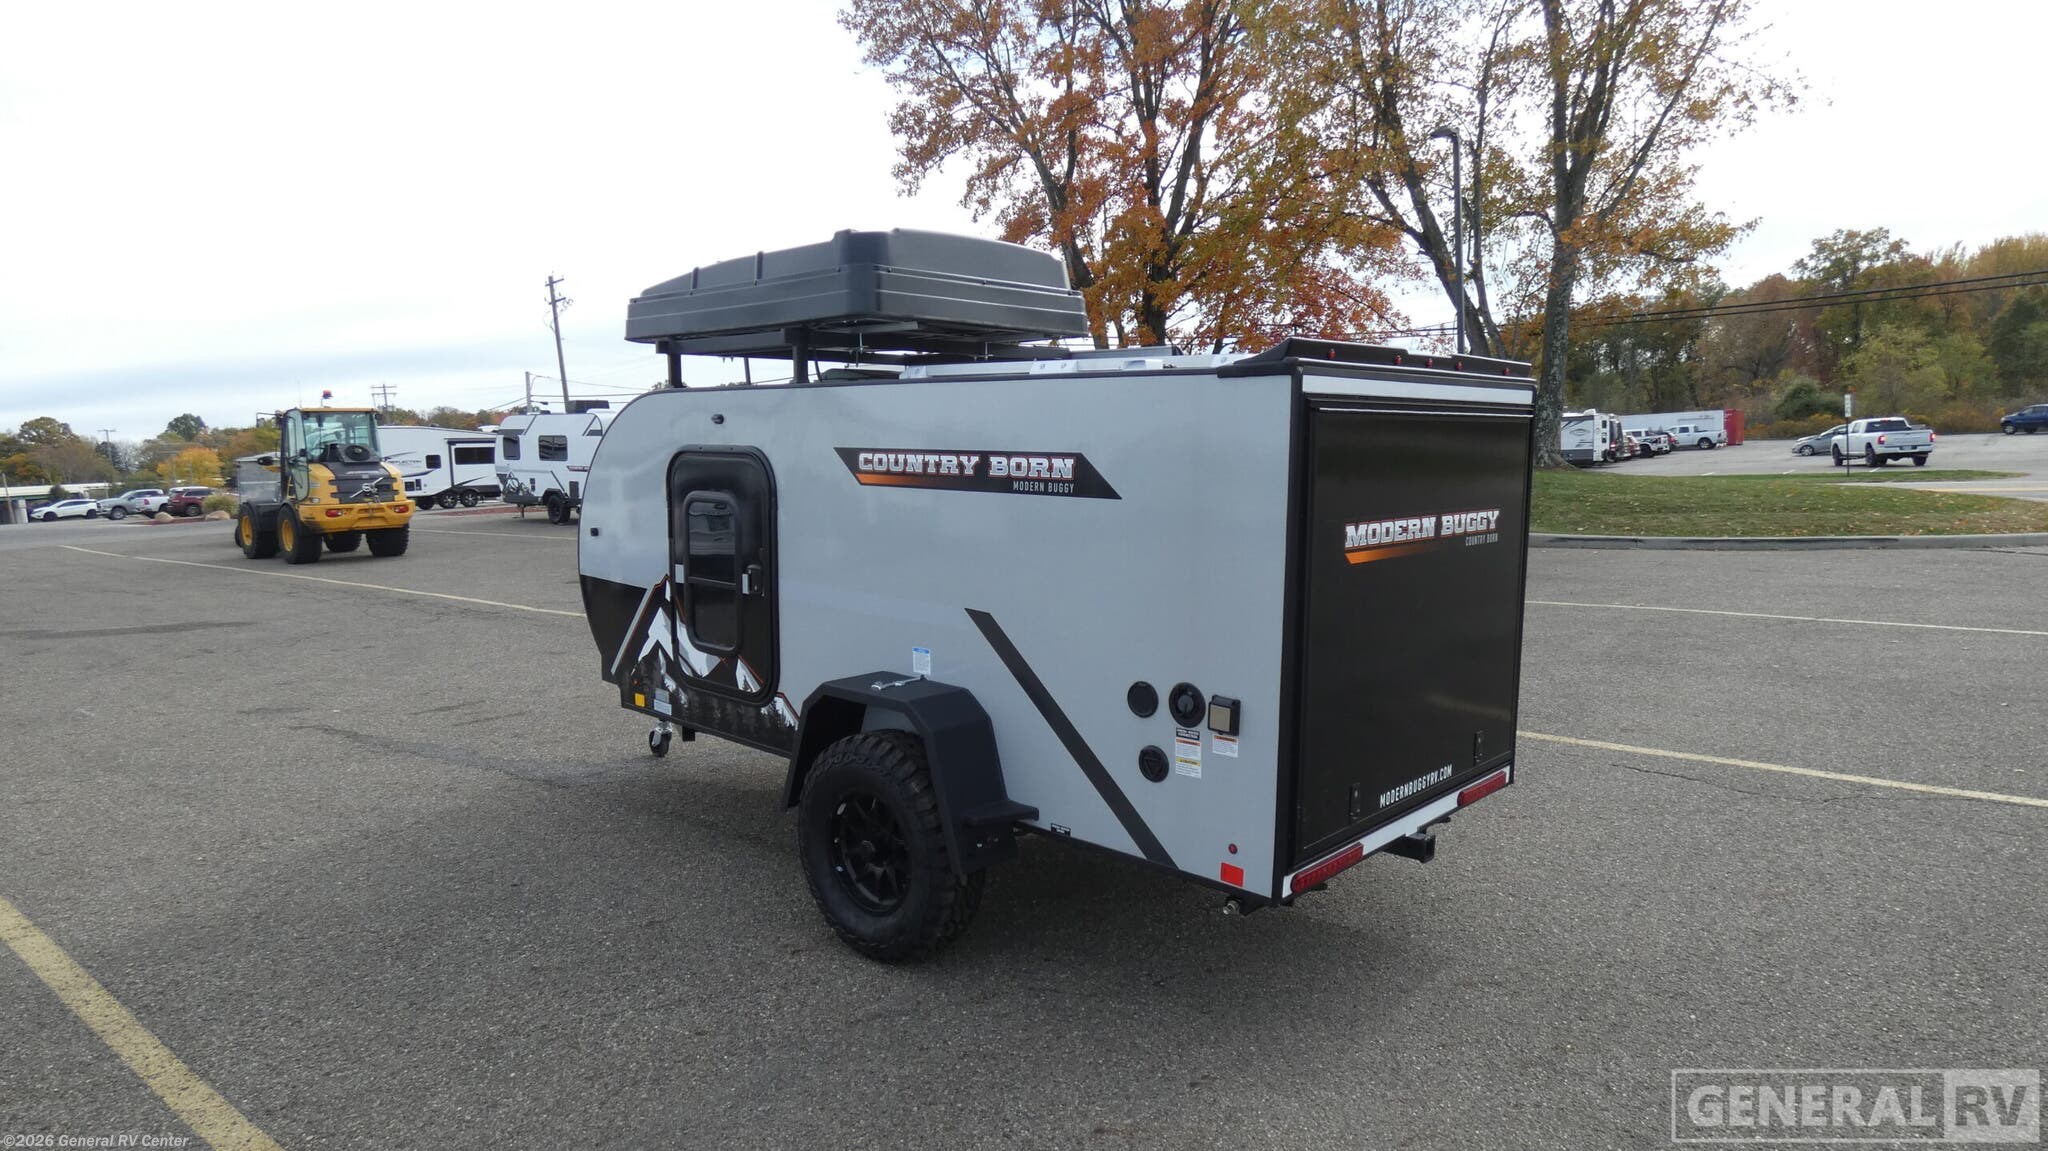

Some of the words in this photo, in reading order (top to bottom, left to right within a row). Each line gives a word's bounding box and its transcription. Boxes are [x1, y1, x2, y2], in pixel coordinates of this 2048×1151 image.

[858, 452, 979, 475] COUNTRY
[989, 456, 1075, 479] BORN
[1013, 481, 1045, 492] MODERN
[1048, 482, 1075, 493] BUGGY
[1345, 516, 1437, 548] MODERN
[1440, 509, 1500, 536] BUGGY
[1379, 763, 1453, 809] MODERNBUGGYRV.COM
